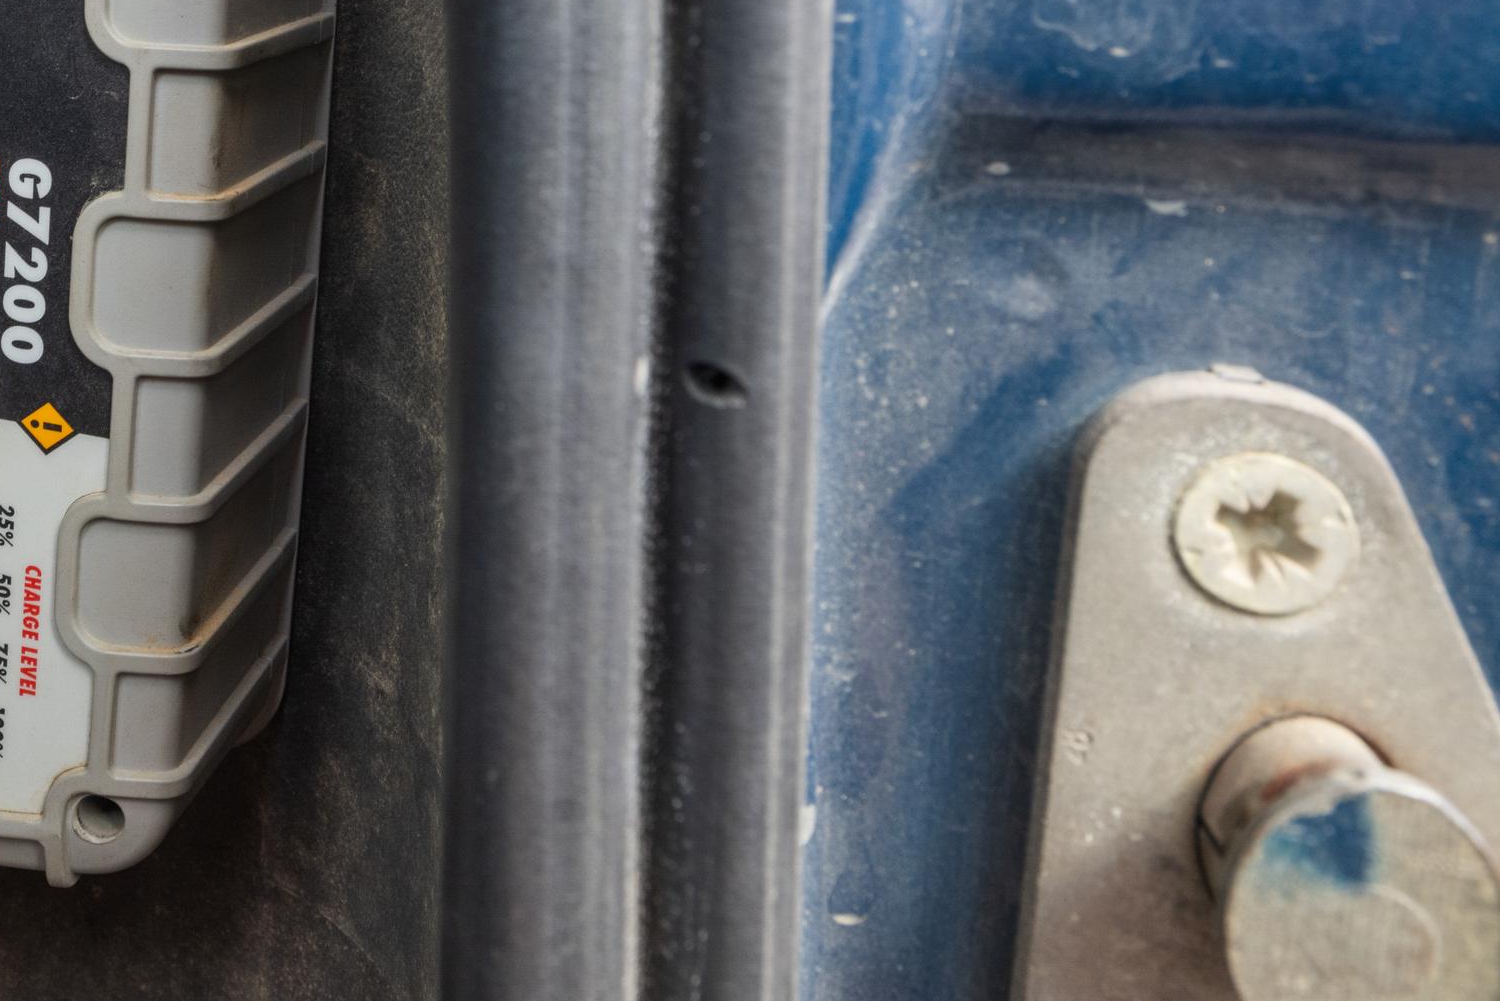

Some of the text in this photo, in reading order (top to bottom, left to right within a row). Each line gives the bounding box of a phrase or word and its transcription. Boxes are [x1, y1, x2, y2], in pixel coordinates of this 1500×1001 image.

[1, 157, 53, 364] G7200
[19, 565, 42, 696] CHARGE LEVEL
